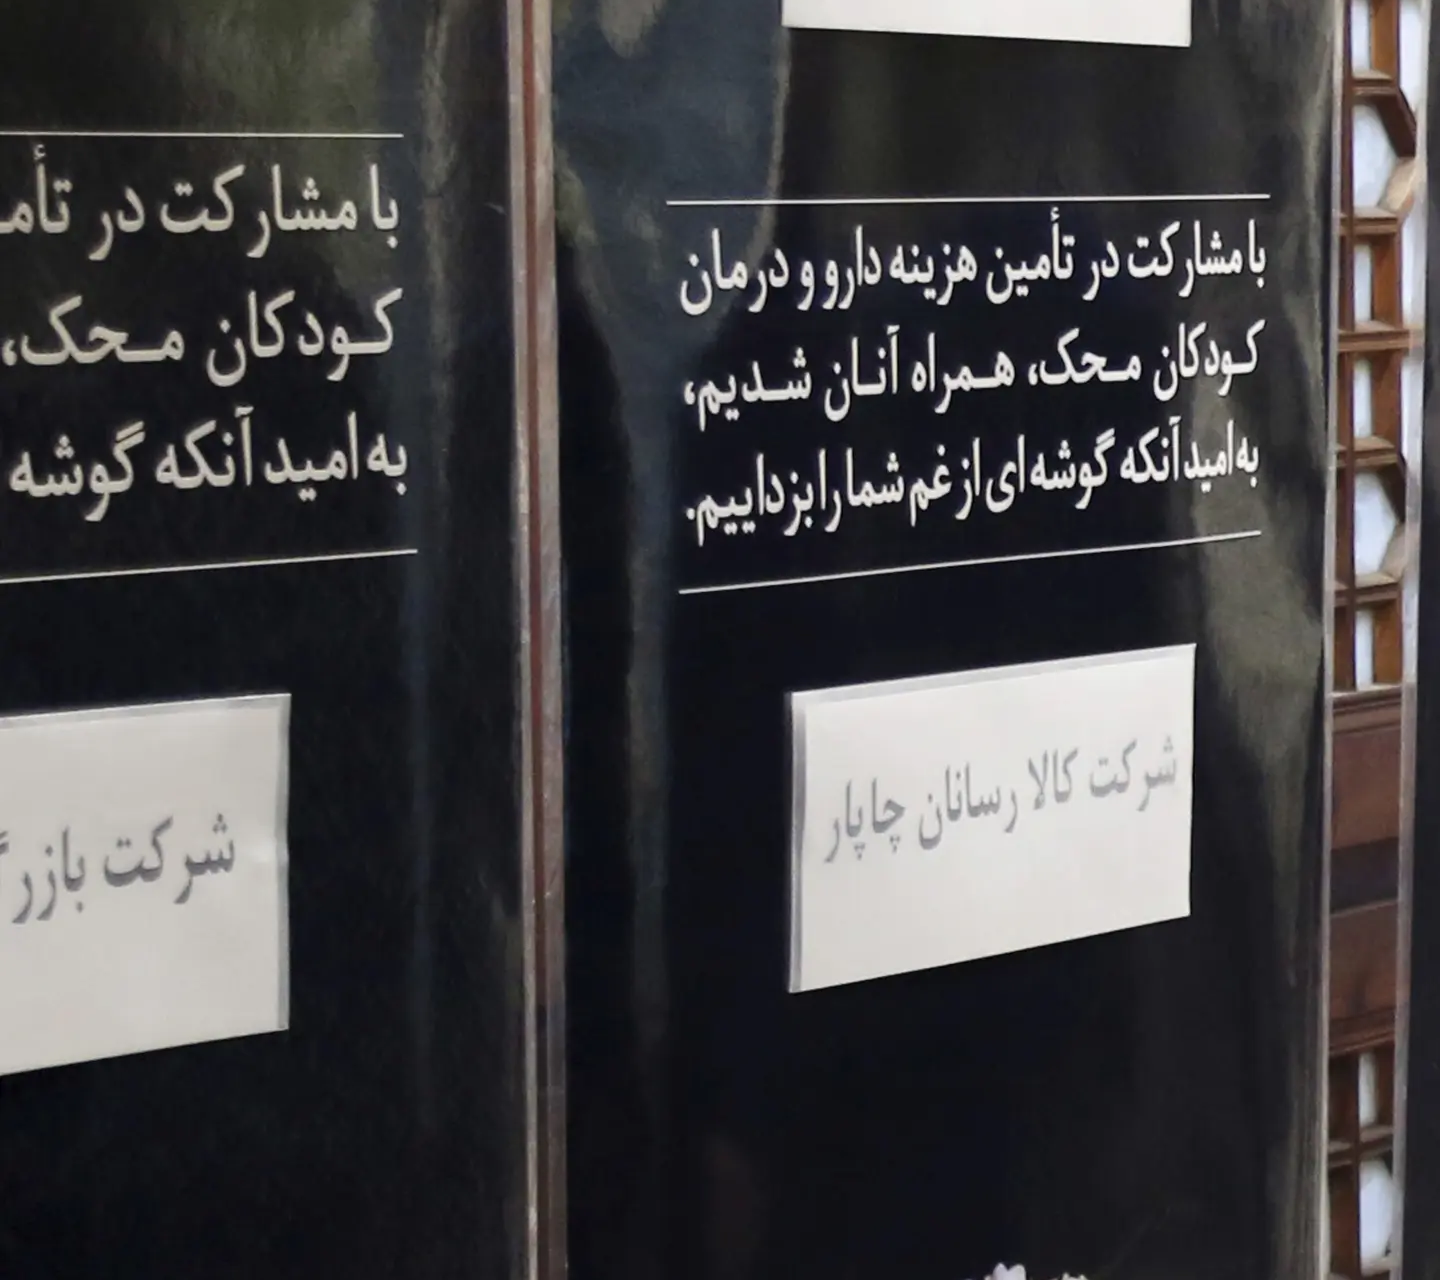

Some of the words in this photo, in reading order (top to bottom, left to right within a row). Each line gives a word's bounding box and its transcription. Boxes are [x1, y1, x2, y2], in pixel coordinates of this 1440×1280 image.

[0, 143, 72, 235] تأم
[88, 186, 145, 261] در
[160, 163, 358, 258] مشارکت
[370, 163, 399, 248] با
[680, 228, 789, 315] درمان
[797, 260, 815, 310] و
[822, 225, 881, 309] دارو
[889, 243, 977, 306] هزینه
[986, 206, 1075, 304] تأمین
[1082, 241, 1119, 301] در
[1127, 220, 1243, 298] مشارکت
[1249, 218, 1266, 288] با
[0, 295, 185, 367] محک،
[206, 287, 403, 386] کودکان
[1153, 319, 1266, 401] کودکان
[824, 324, 900, 421] آنان
[911, 332, 1015, 413] همراه
[155, 406, 254, 491] آنکه
[264, 410, 358, 501] امید
[366, 433, 408, 495] به
[846, 447, 904, 507] شما
[910, 444, 951, 527] غم
[955, 437, 980, 520] از
[1120, 416, 1181, 484] آنکه
[1184, 419, 1234, 493] امید
[1235, 437, 1259, 487] به
[818, 448, 841, 532] را
[918, 762, 1018, 850] رسانان
[1027, 747, 1079, 811] کالا
[1089, 734, 1178, 812] شرکت
[103, 812, 235, 905] شرکت
[824, 777, 906, 863] چاپار
